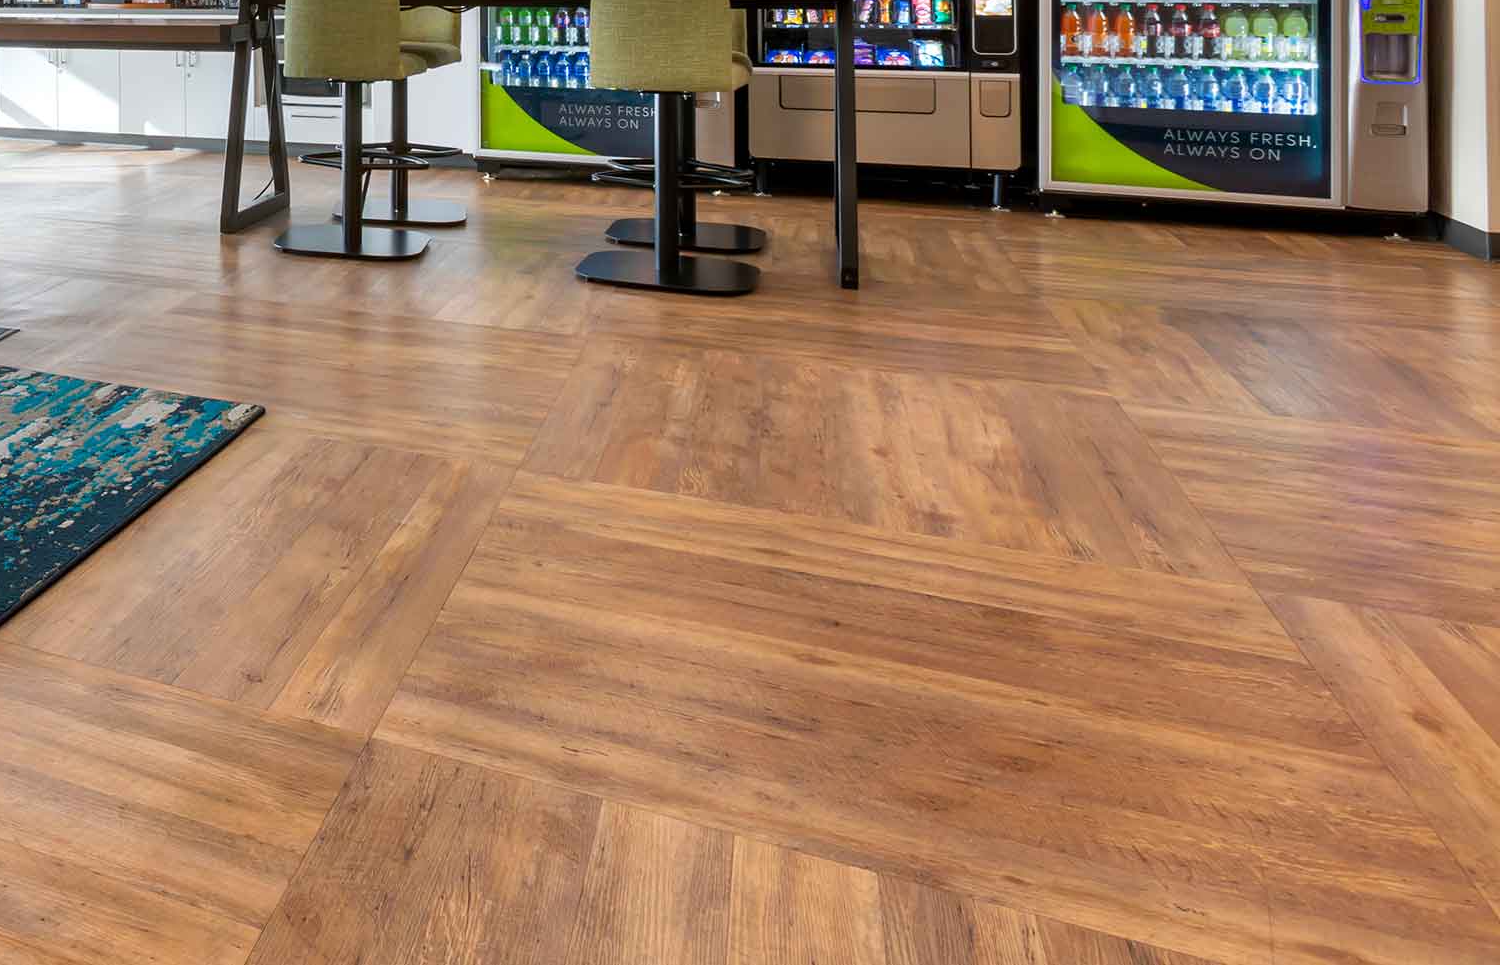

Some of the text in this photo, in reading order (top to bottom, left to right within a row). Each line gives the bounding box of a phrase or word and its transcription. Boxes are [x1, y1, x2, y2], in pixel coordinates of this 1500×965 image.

[558, 103, 612, 116] ALWAYS
[559, 116, 640, 130] ALWAYS ON
[1163, 128, 1317, 149] ALWAYS FRESH.
[1163, 143, 1282, 161] ALWAYS ON
